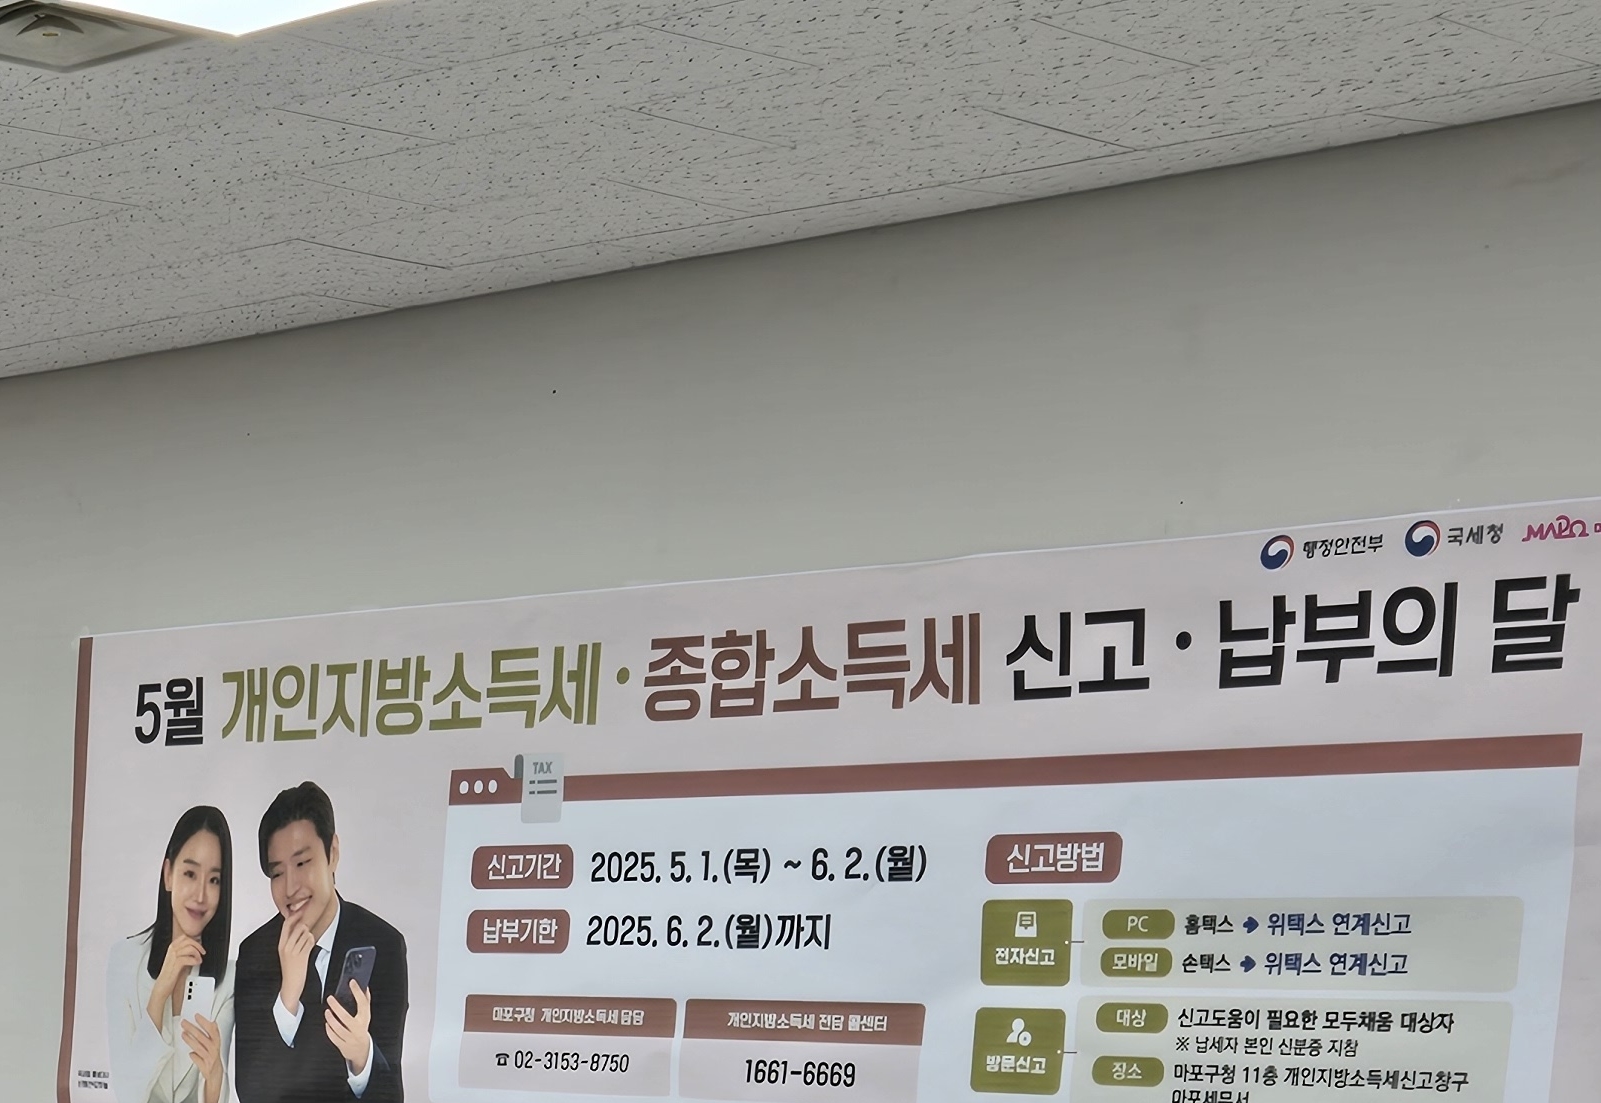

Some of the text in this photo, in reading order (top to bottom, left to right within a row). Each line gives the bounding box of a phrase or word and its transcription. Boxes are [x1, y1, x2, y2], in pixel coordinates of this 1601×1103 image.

[1303, 533, 1383, 559] 행정안전부
[1448, 523, 1503, 546] 국세청
[134, 677, 204, 747] 5월
[1492, 573, 1580, 673] 달
[532, 761, 553, 775] TAX
[487, 853, 562, 881] 신고기간
[1006, 842, 1105, 873] 신고방법
[483, 917, 557, 945] 납부기한
[1127, 912, 1412, 936] PC 홈택스 위택스 연계신고
[995, 947, 1055, 967] 전자신고
[1112, 952, 1408, 976] 모바일 손택스 위택스 연계신고
[1116, 1008, 1454, 1033] 대상 신고도움이 필요한 모두채움 대상자
[1195, 1036, 1238, 1054] 납세자
[1244, 1037, 1274, 1055] 본인
[1278, 1038, 1322, 1057] 신분증
[1327, 1039, 1358, 1057] 지참
[514, 1050, 629, 1073] 02-3153-8750
[745, 1059, 856, 1087] 1661-6669
[986, 1055, 1046, 1074] 방문신고
[1112, 1062, 1142, 1080] 장소
[1174, 1064, 1236, 1084] 마포구청
[1243, 1065, 1278, 1086] 11층
